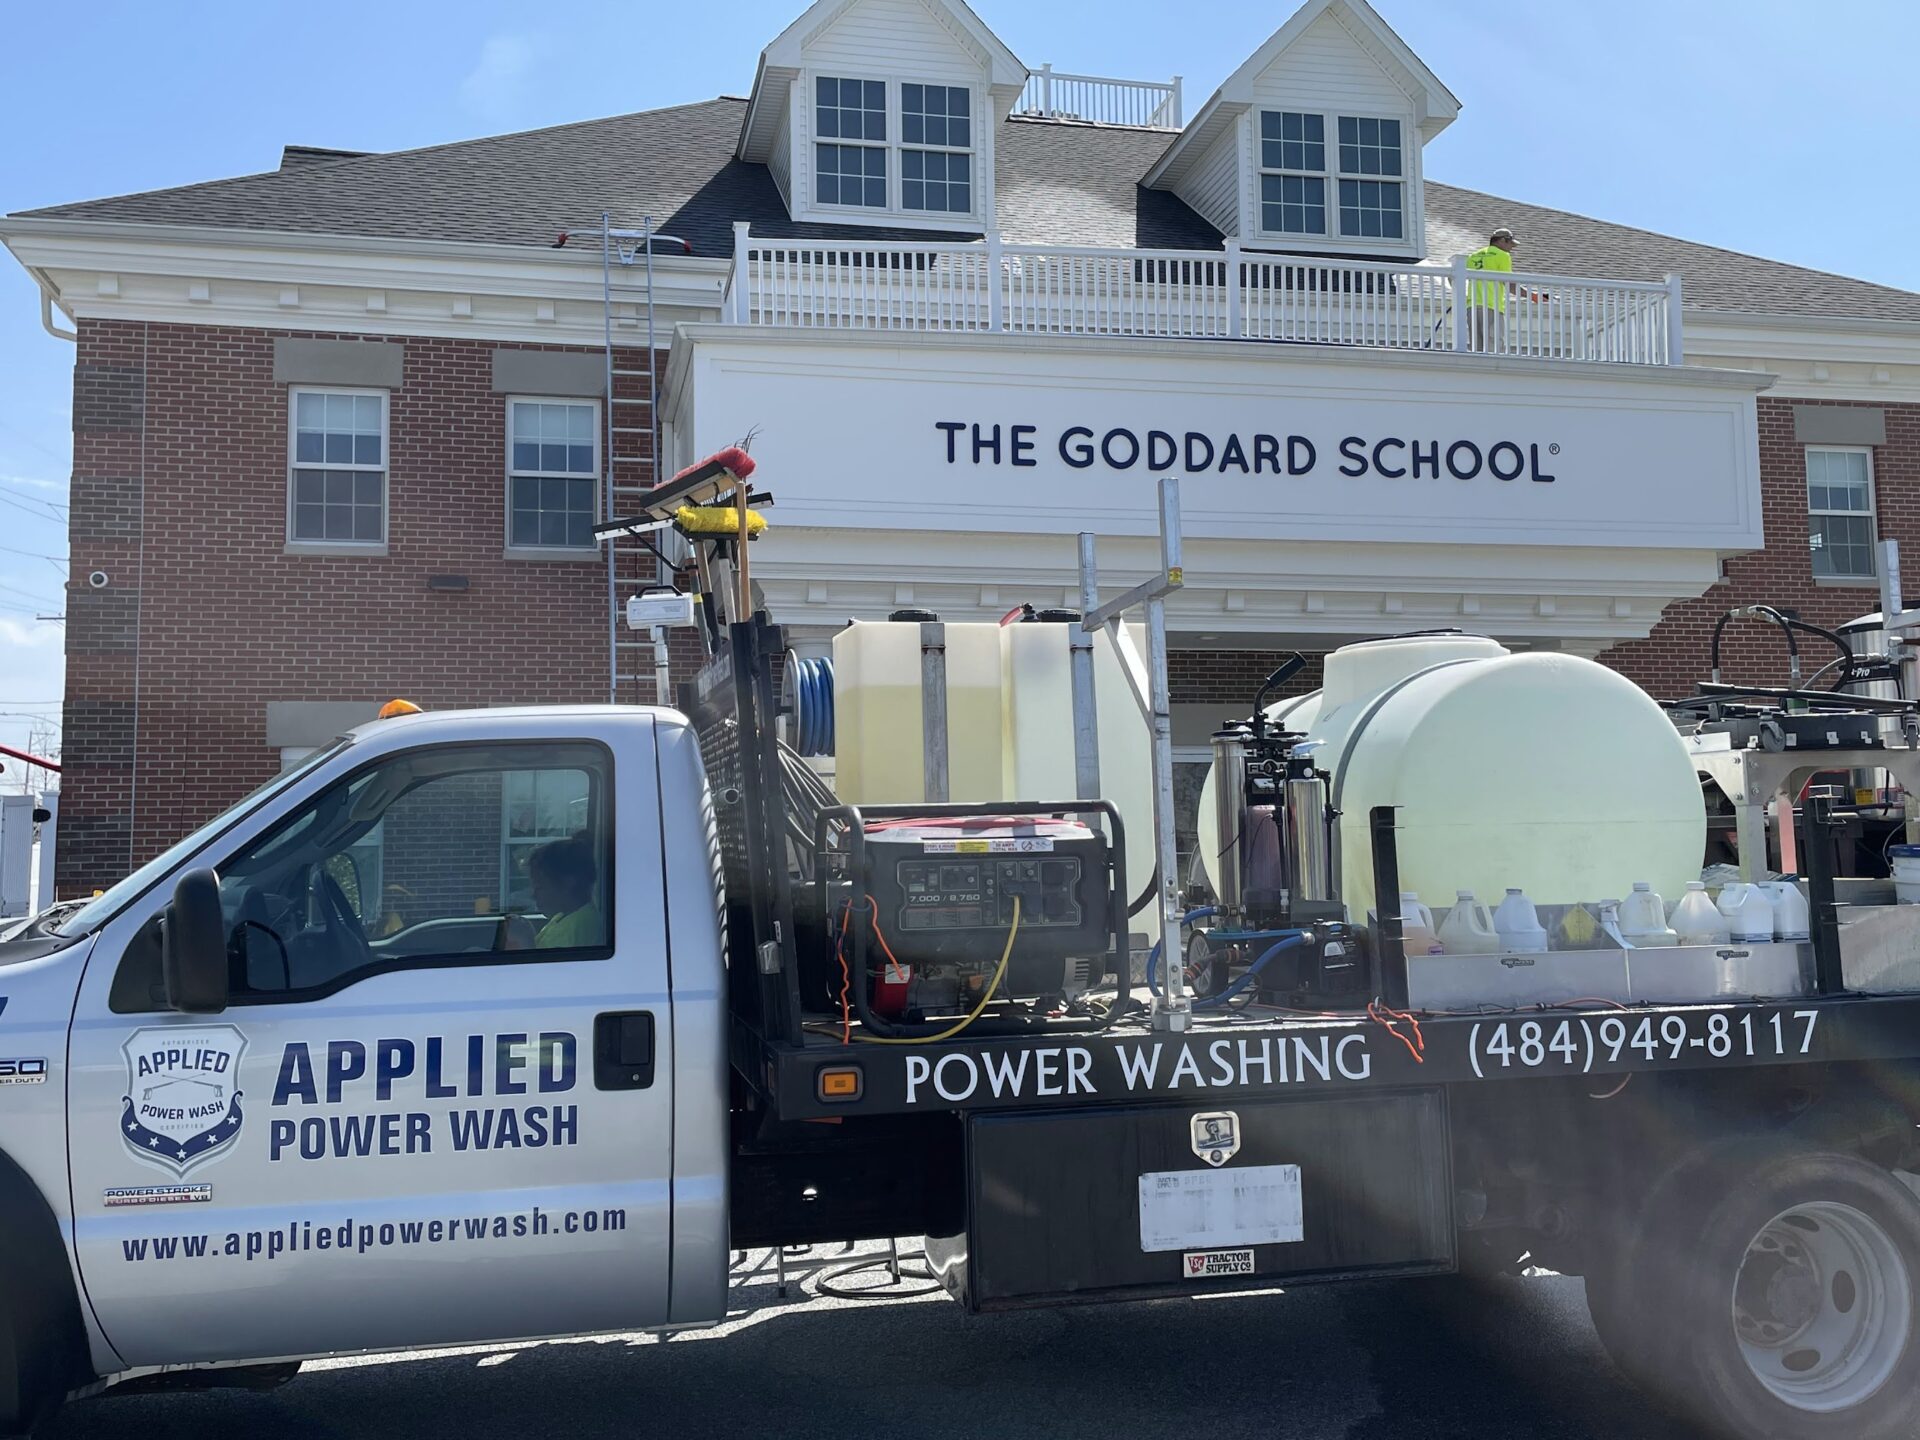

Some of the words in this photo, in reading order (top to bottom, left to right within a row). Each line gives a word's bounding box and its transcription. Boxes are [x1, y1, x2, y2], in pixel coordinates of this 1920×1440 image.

[935, 421, 1037, 467] THE
[1058, 426, 1317, 476] GODDARD
[138, 1049, 231, 1077] APPLIED
[271, 1031, 578, 1106] APPLIED
[904, 1047, 1099, 1104] POWER
[1114, 1034, 1372, 1091] WASHING
[1469, 1010, 1820, 1078] (484)949-8117
[140, 1104, 184, 1120] POWER
[189, 1100, 225, 1118] WASH
[270, 1112, 432, 1161] POWER
[448, 1104, 578, 1151] WASH
[122, 1206, 627, 1262] www.appliedpowerwash.com
[1206, 1252, 1251, 1264] TRACTOR
[1206, 1262, 1240, 1274] SUPPLY
